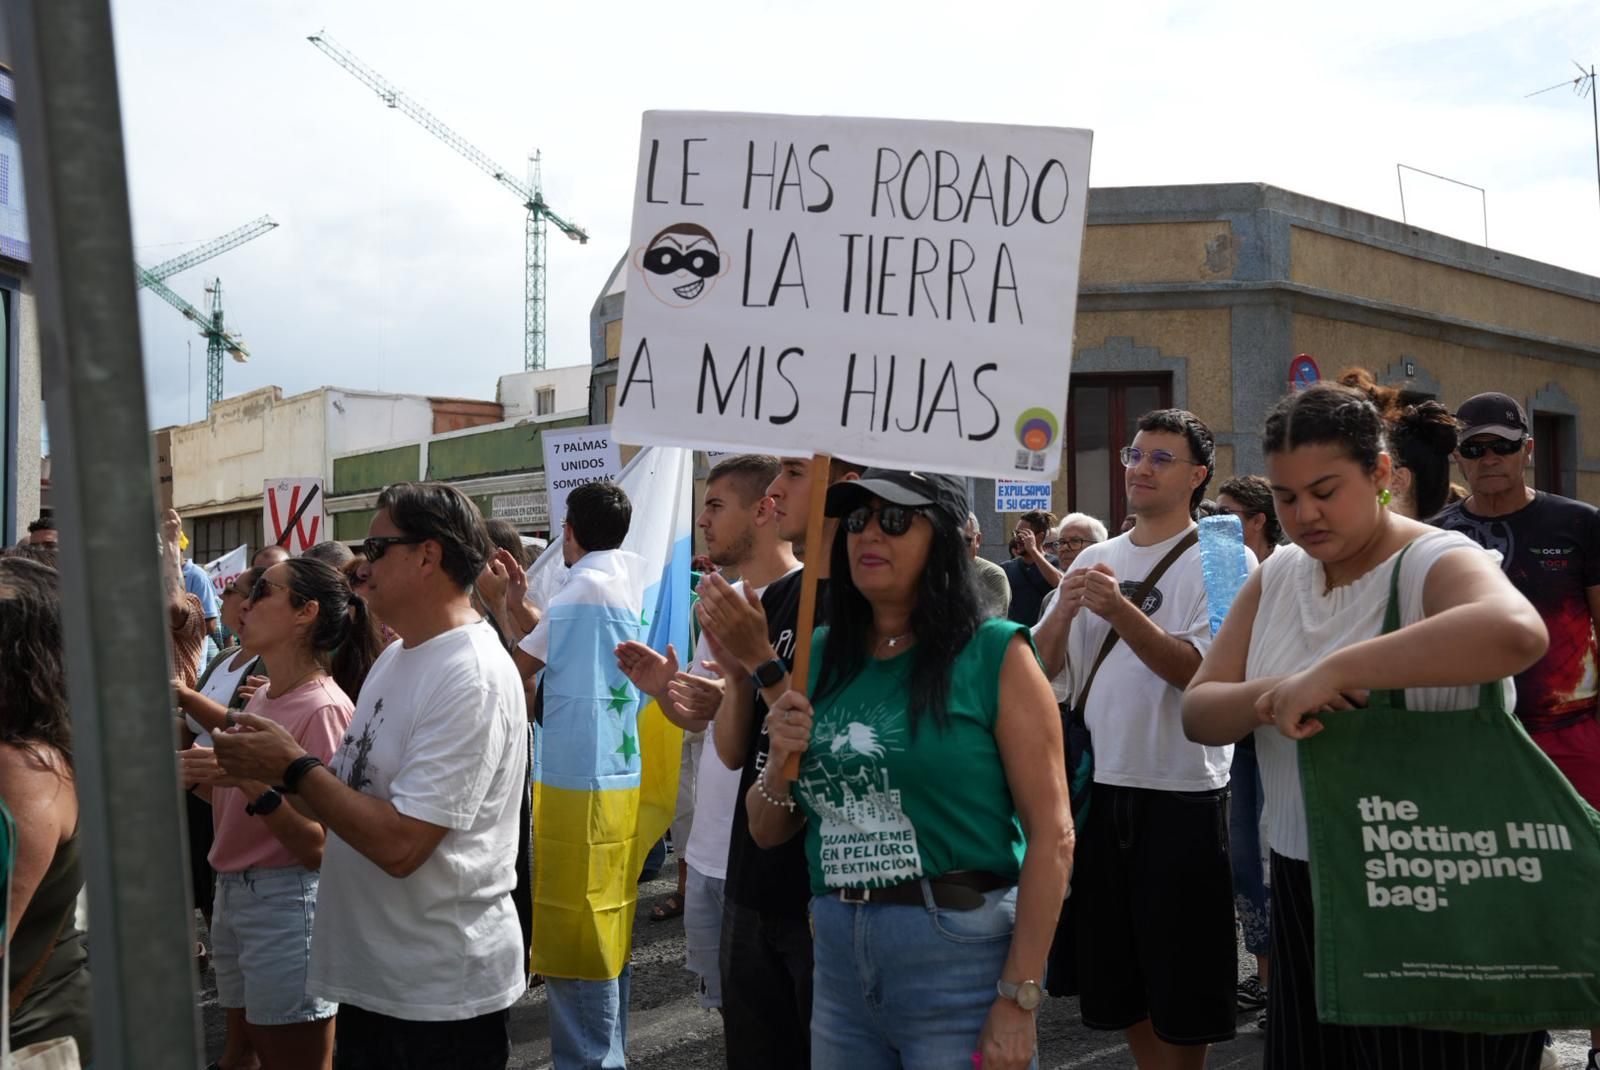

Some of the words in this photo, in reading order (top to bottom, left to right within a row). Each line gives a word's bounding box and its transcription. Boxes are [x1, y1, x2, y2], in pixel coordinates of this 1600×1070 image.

[646, 138, 708, 206] LE
[742, 140, 835, 213] HAS
[871, 147, 1069, 227] ROBADO
[742, 228, 809, 309] LA
[840, 233, 1023, 325] TIERRA
[618, 337, 656, 410] A
[696, 342, 805, 425] MIS
[840, 352, 1001, 442] HIJAS
[553, 444, 560, 454] 7
[563, 439, 608, 453] PALMAS
[561, 457, 605, 471] UNIDOS
[553, 477, 590, 490] SOMOS
[1007, 498, 1018, 510] SU
[1019, 498, 1047, 510] GENTE
[1357, 796, 1419, 822] the
[1362, 824, 1498, 857] Notting
[1506, 822, 1573, 850] Hill
[823, 848, 839, 861] EN
[843, 843, 914, 860] PELIGRO
[823, 864, 838, 875] DE
[1365, 852, 1543, 885] shopping
